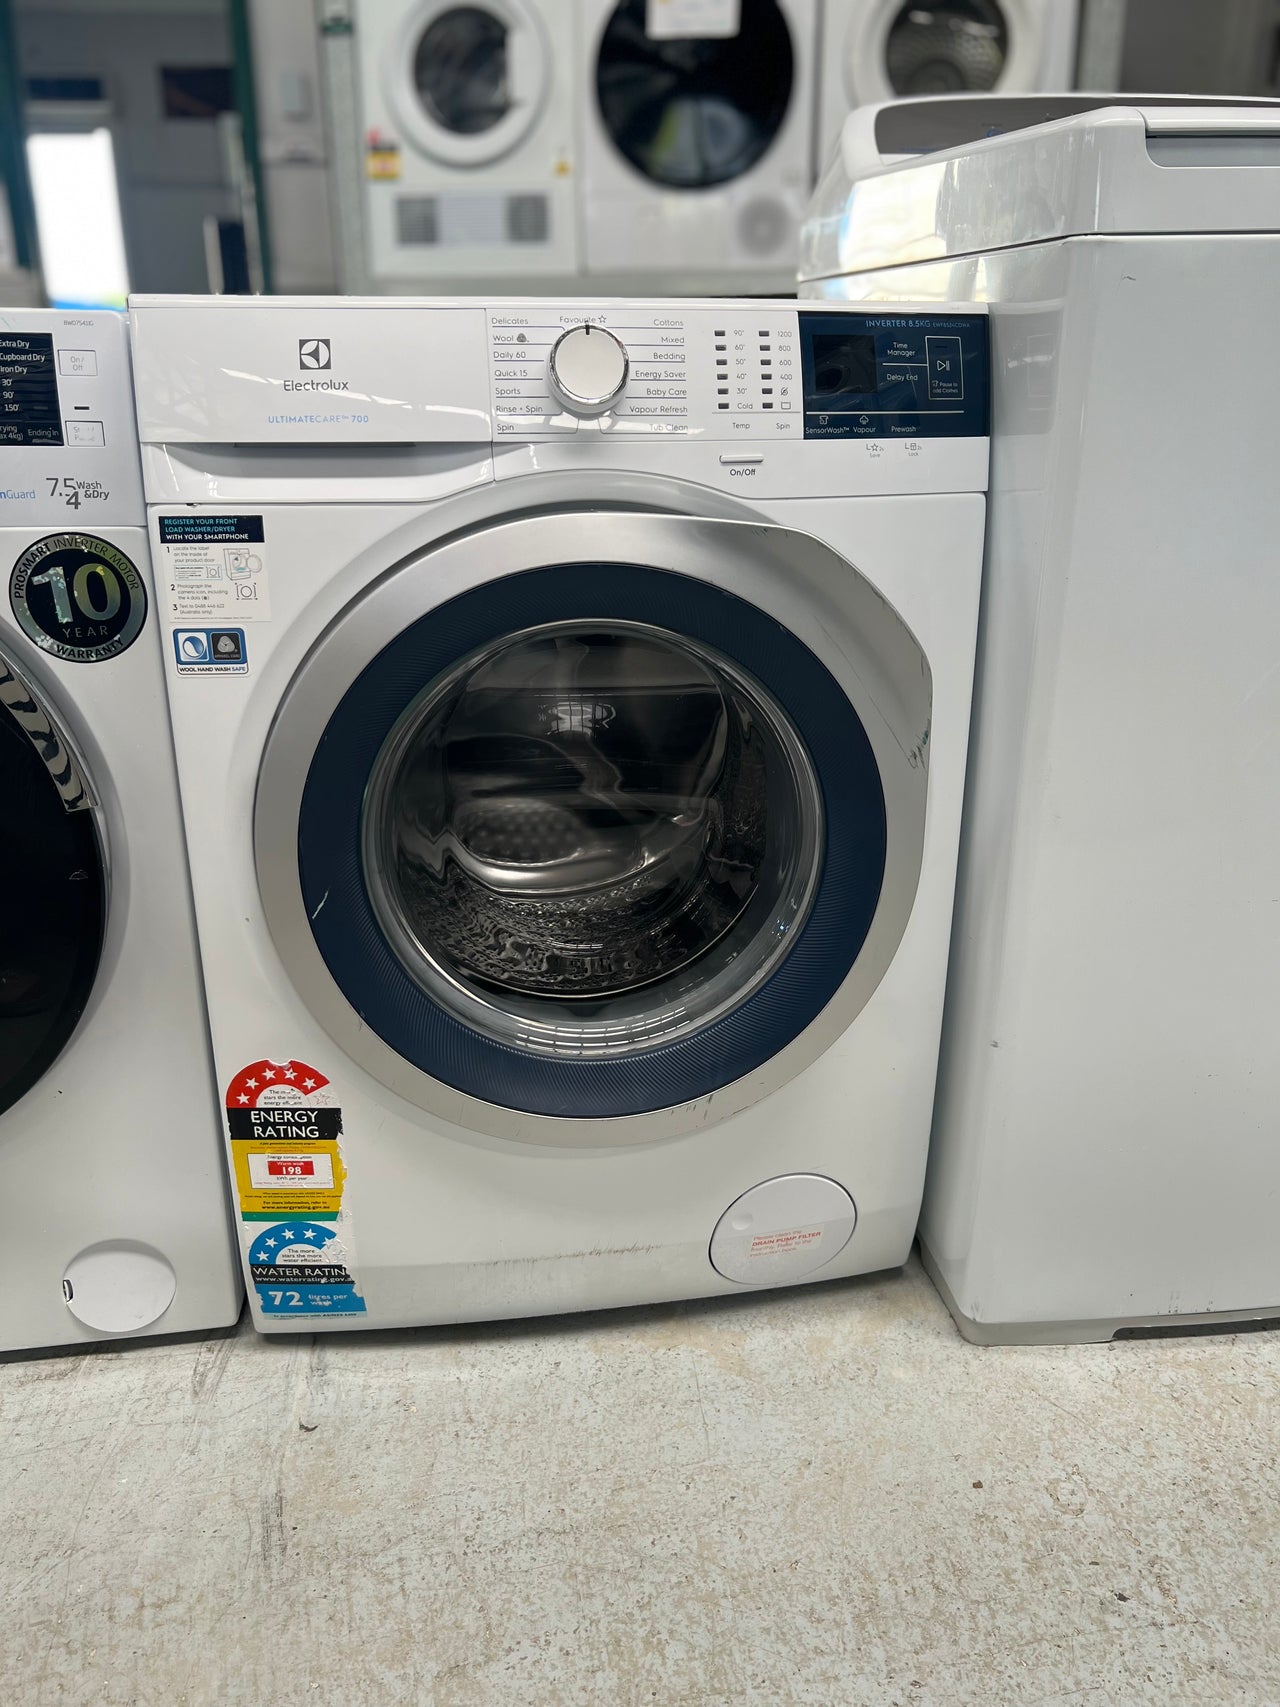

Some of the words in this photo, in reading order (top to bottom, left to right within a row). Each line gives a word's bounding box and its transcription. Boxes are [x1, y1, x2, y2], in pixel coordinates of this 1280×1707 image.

[492, 317, 529, 325] Delicates
[654, 319, 684, 327] Cottons
[866, 320, 907, 328] INVERTER
[908, 320, 931, 328] 8.5KG
[17, 340, 29, 349] Dry
[493, 351, 513, 360] Daily
[654, 352, 686, 362] Bedding
[887, 349, 916, 358] Manager
[0, 354, 32, 362] Cupboard
[33, 354, 45, 363] Dry
[15, 366, 27, 374] Dry
[495, 370, 518, 378] Quick
[635, 370, 662, 380] Energy
[664, 370, 687, 378] Saver
[887, 374, 905, 382] Delay
[283, 379, 349, 391] Electrolux
[495, 388, 521, 397] Sports
[647, 388, 666, 397] Baby
[668, 388, 688, 396] Care
[525, 405, 543, 414] Spin
[629, 406, 658, 414] Vapour
[659, 405, 688, 413] Refresh
[351, 415, 369, 423] 700
[496, 424, 515, 432] Spin
[732, 422, 750, 430] Temp
[775, 422, 791, 430] Spin
[28, 429, 52, 438] Ending
[730, 468, 756, 477] On/Off
[76, 481, 102, 490] Wash
[66, 491, 81, 510] 4
[84, 490, 110, 501] &Dry
[184, 526, 236, 534] WASHER/DRYER
[14, 542, 51, 599] PROSMART
[54, 537, 109, 556] INVERTER
[109, 553, 139, 590] MOTOR
[170, 583, 176, 592] 2
[31, 562, 122, 625] 10
[173, 603, 178, 611] 3
[62, 625, 109, 639] YEAR
[56, 638, 124, 659] WARRANTY
[250, 1110, 319, 1123] ENERGY
[253, 1125, 320, 1138] RATING
[281, 1166, 302, 1175] 198
[752, 1239, 775, 1247] DRAIN
[798, 1231, 822, 1240] FILTER
[252, 1267, 302, 1276] WATER
[268, 1291, 304, 1306] 72
